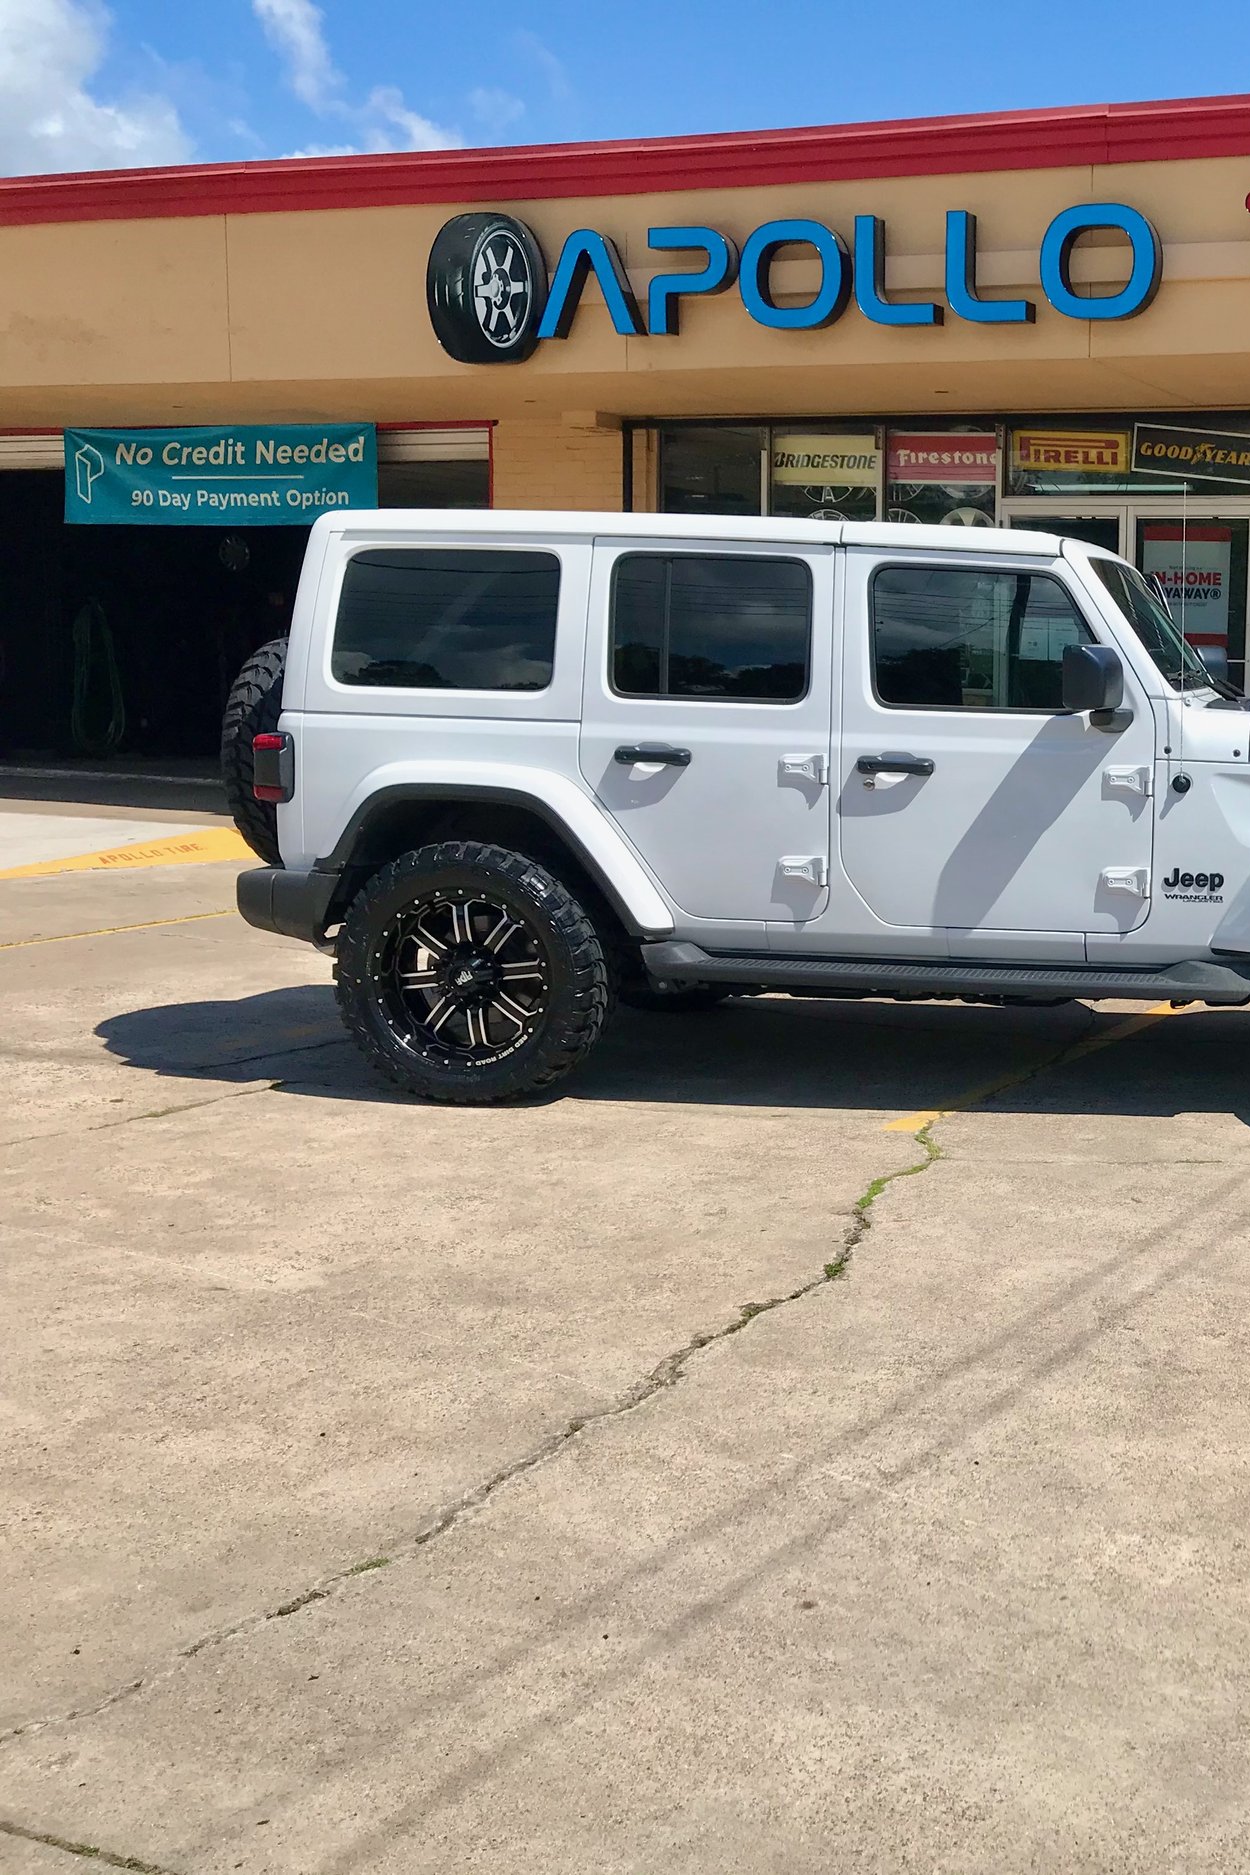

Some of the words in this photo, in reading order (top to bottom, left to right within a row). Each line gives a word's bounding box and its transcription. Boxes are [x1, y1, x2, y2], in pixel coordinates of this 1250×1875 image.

[537, 203, 1162, 339] APOLLO
[115, 442, 153, 466] No
[163, 439, 246, 466] Credit
[255, 436, 365, 465] Needed
[774, 452, 877, 469] BRIDGESTONE
[1020, 437, 1119, 466] PIRELLI
[131, 490, 154, 507] 90
[158, 490, 190, 510] Day
[197, 489, 280, 510] Payment
[286, 488, 349, 509] Option
[98, 849, 164, 865] APOLLO
[163, 843, 204, 855] TIRE
[1163, 868, 1224, 891] Jeep
[515, 1034, 528, 1048] RED
[475, 1056, 497, 1066] ROAD
[498, 1047, 515, 1059] DIRT
